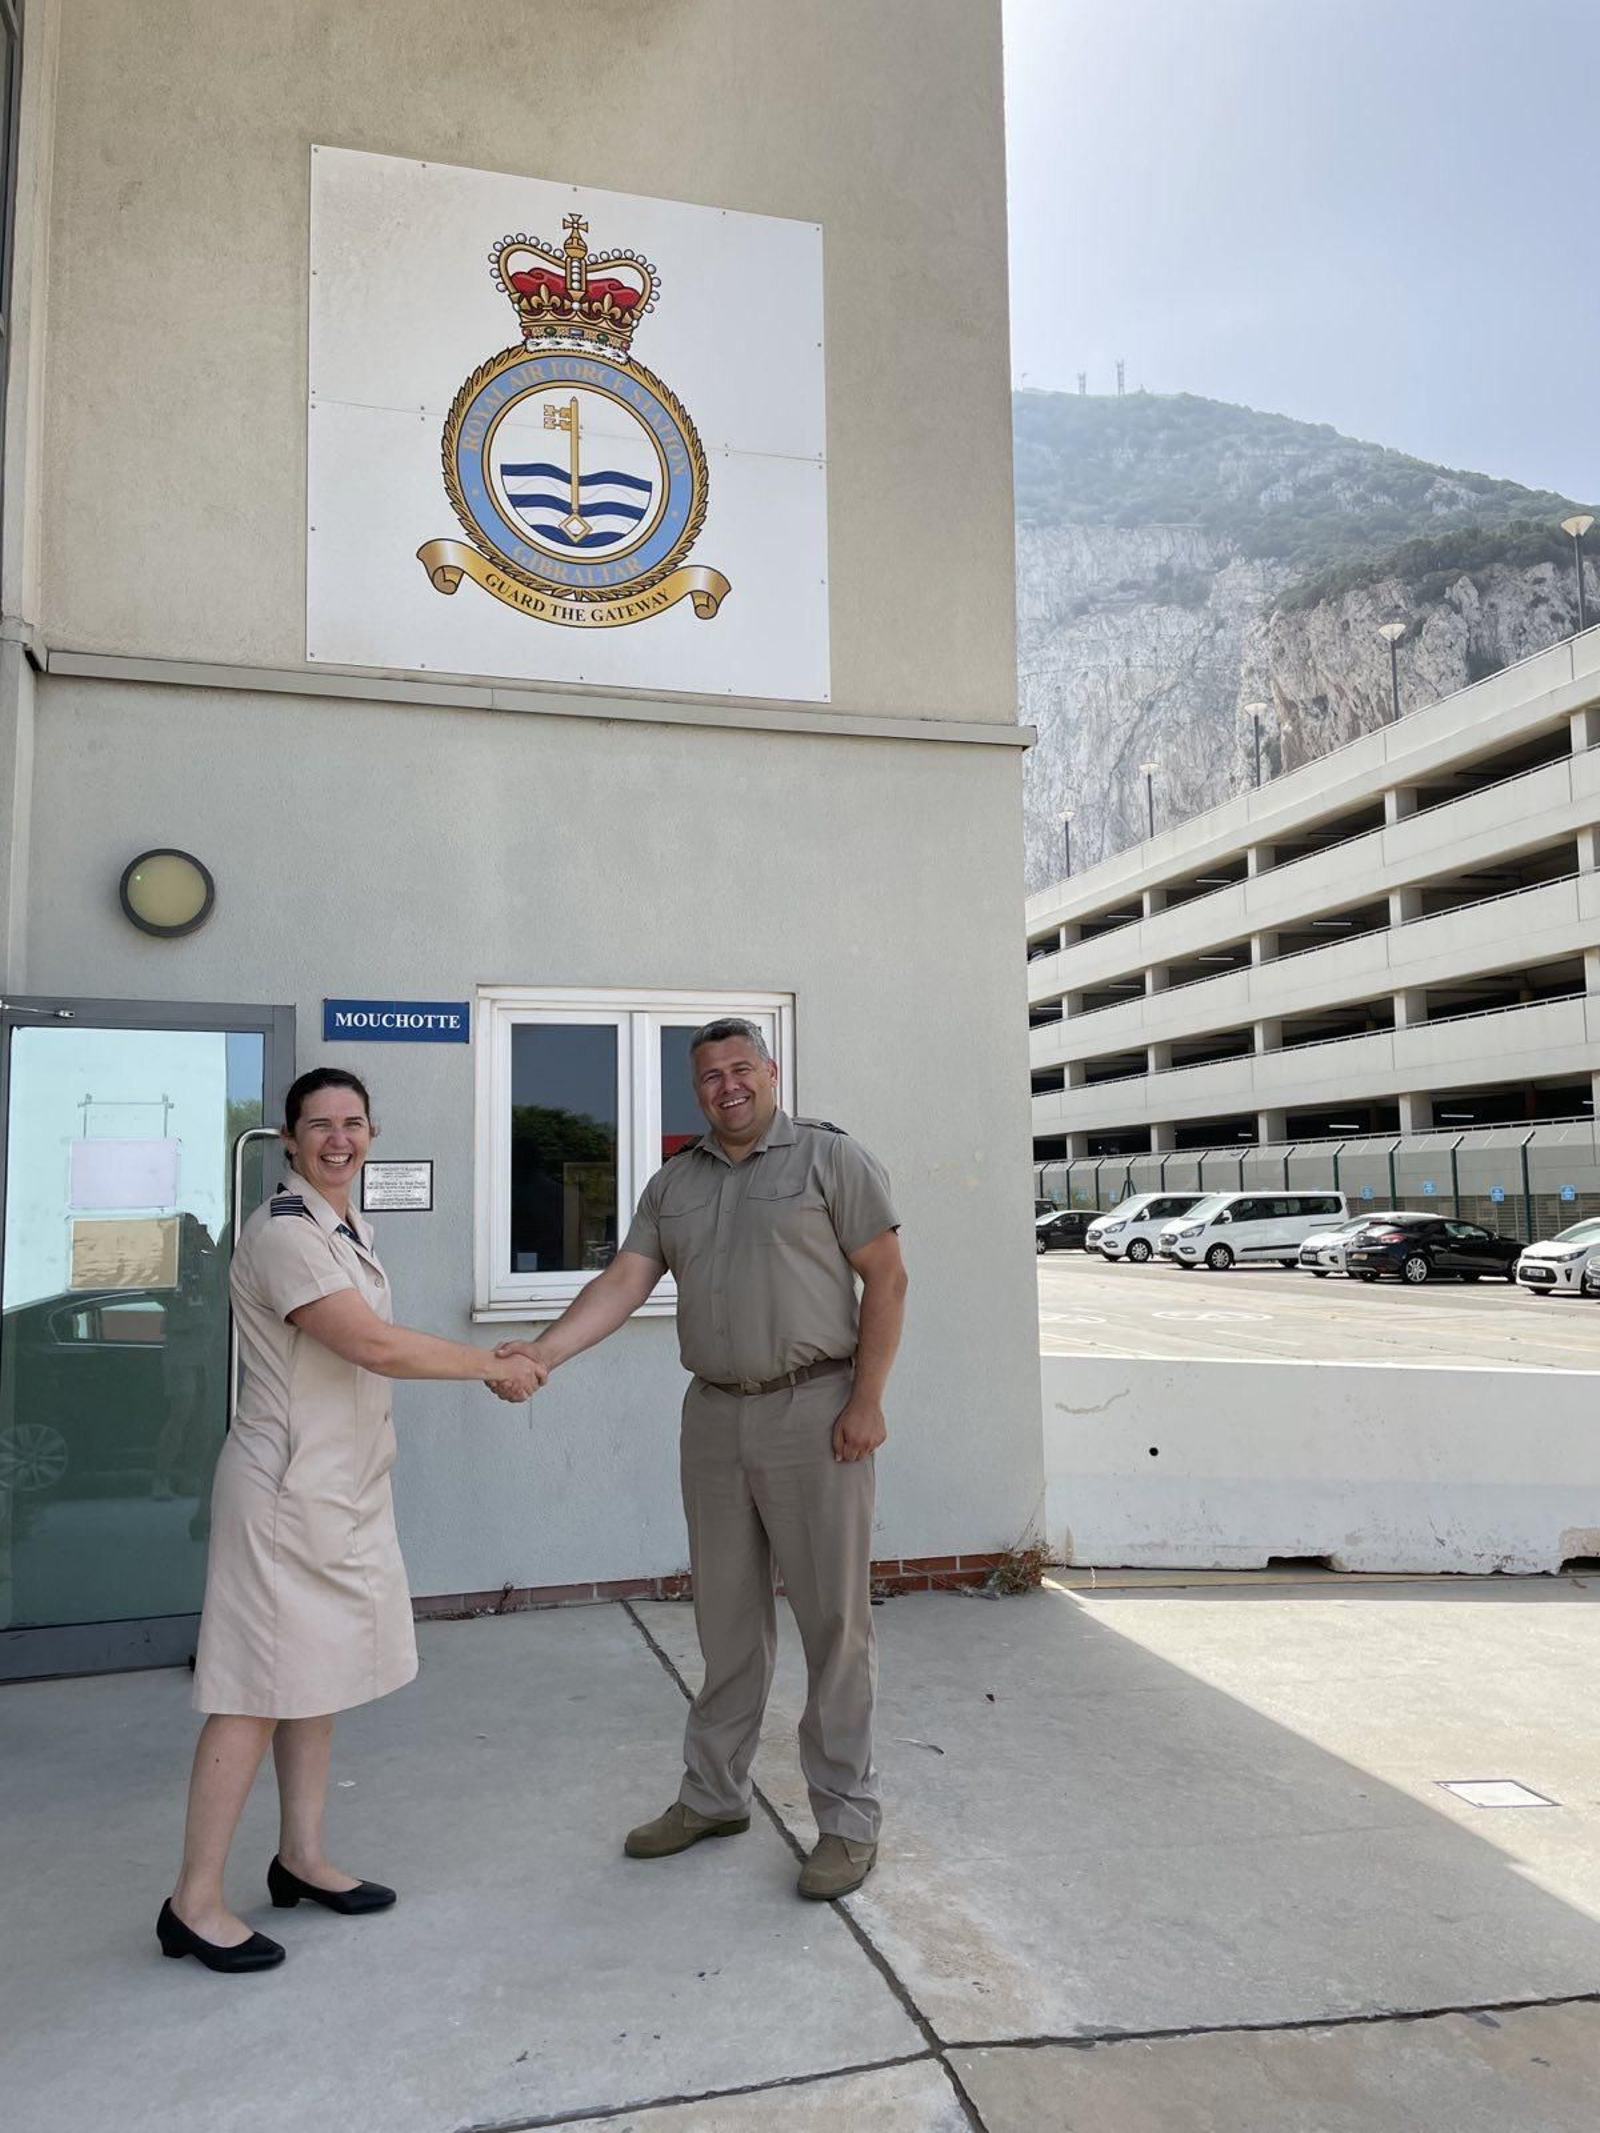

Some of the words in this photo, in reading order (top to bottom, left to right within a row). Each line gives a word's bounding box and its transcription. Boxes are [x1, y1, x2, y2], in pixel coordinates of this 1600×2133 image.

[510, 363, 545, 389] AIR
[551, 361, 627, 389] FORCE
[485, 572, 546, 613] GUARD
[550, 603, 586, 622] THE
[591, 588, 670, 622] GATEWAY
[335, 1012, 461, 1029] MOUCHOTTE
